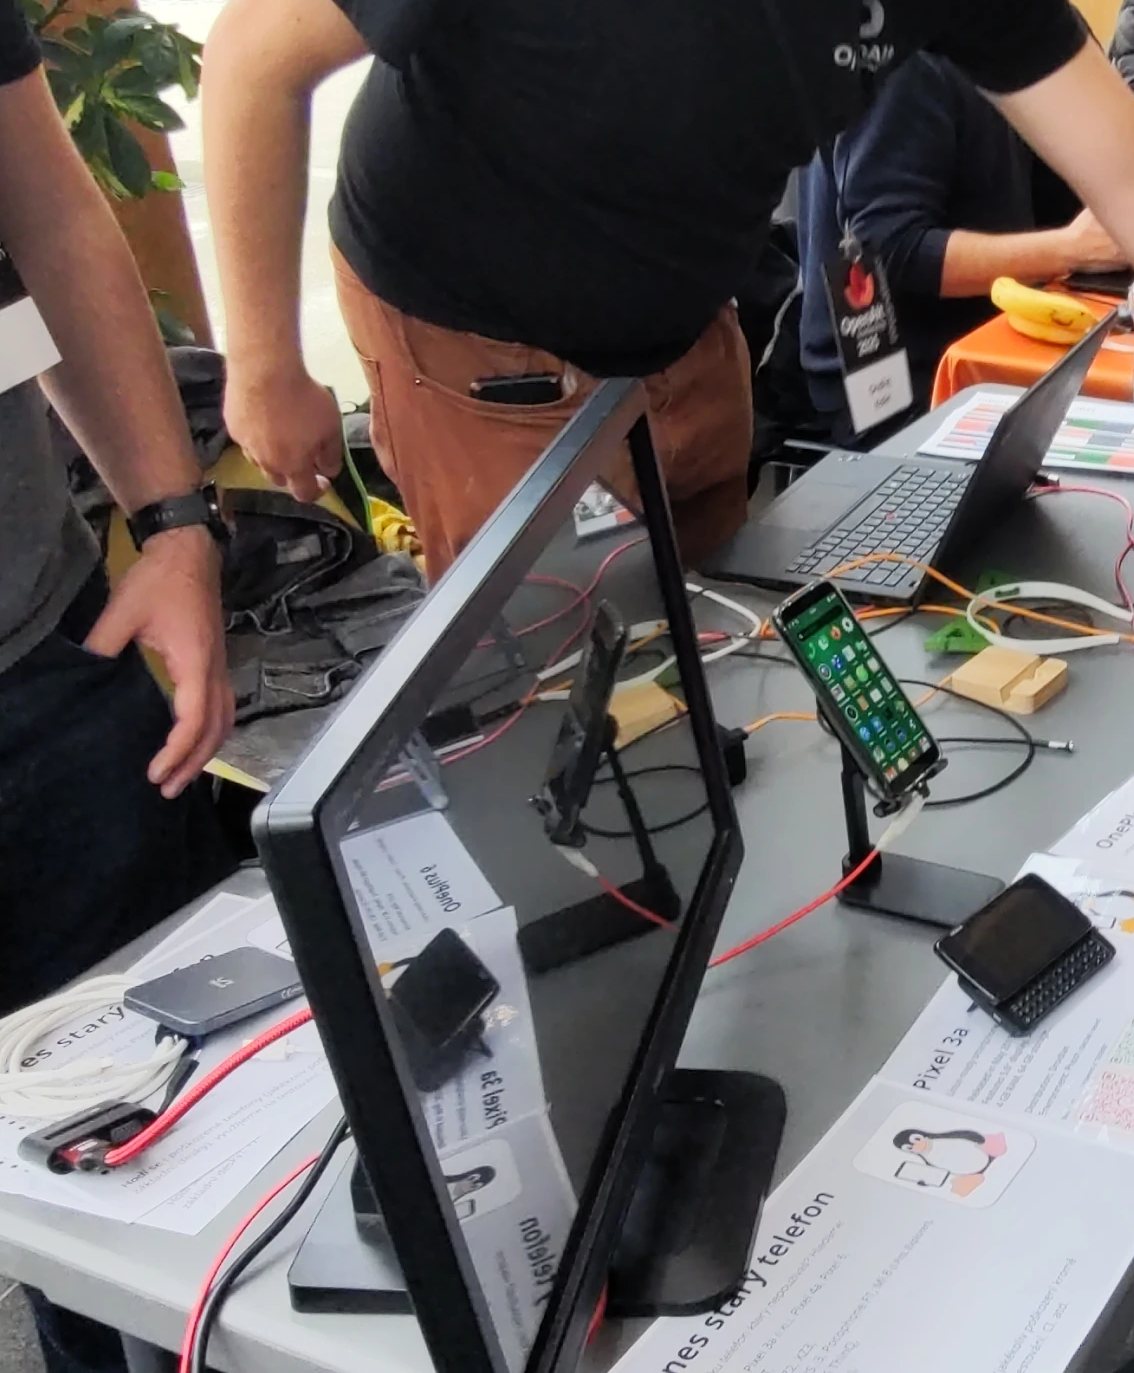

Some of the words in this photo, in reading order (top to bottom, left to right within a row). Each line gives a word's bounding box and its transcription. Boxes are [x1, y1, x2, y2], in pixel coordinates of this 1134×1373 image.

[57, 1005, 125, 1048] starý
[913, 1049, 955, 1091] Pixel
[942, 1028, 969, 1047] 3a
[757, 1189, 834, 1267] telefon
